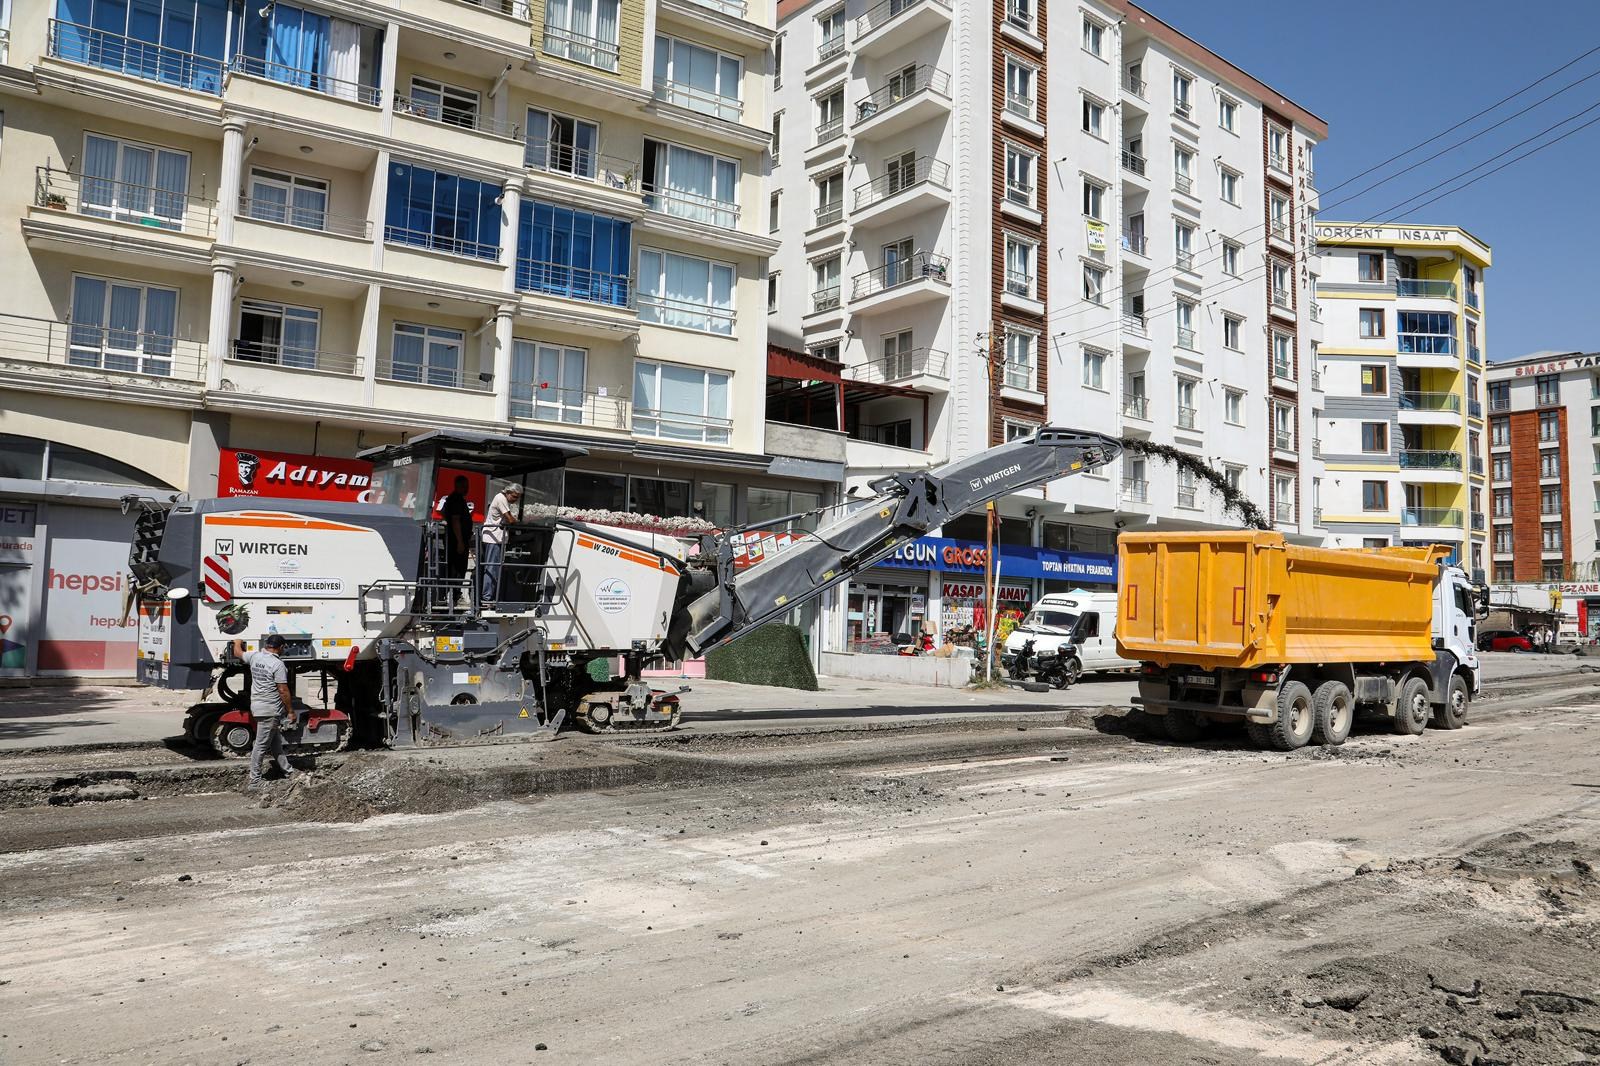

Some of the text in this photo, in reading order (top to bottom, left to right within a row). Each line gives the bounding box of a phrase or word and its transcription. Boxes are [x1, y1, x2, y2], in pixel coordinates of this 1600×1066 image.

[1515, 361, 1567, 376] SMART
[982, 463, 1021, 484] WIRTGEN
[239, 542, 308, 556] WIRTGEN
[243, 580, 341, 591] VAN BÜYÜKŞEHİR BELEDİYESİ
[943, 584, 984, 598] KASAP
